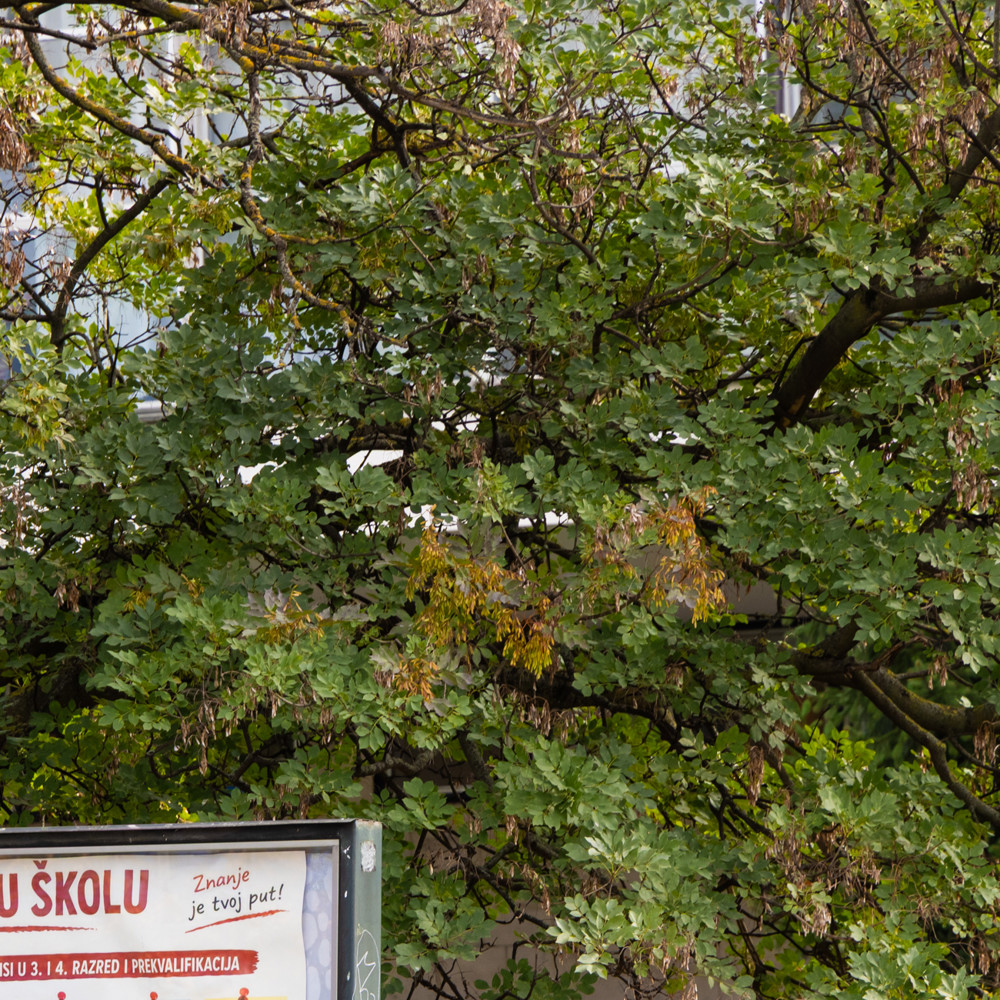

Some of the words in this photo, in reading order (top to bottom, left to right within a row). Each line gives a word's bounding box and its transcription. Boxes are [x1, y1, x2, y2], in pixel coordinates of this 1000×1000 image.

[30, 860, 149, 917] ŠKOLU
[192, 867, 250, 893] Znanje
[188, 901, 205, 921] je
[212, 892, 242, 913] tvoj
[249, 883, 284, 910] put!
[18, 961, 26, 976] U
[30, 961, 42, 976] 3.
[46, 960, 51, 976] I
[55, 960, 68, 976] 4.
[72, 959, 120, 975] RAZRED
[124, 959, 128, 974] I
[132, 956, 240, 974] PREKVALIFIKACIJA
